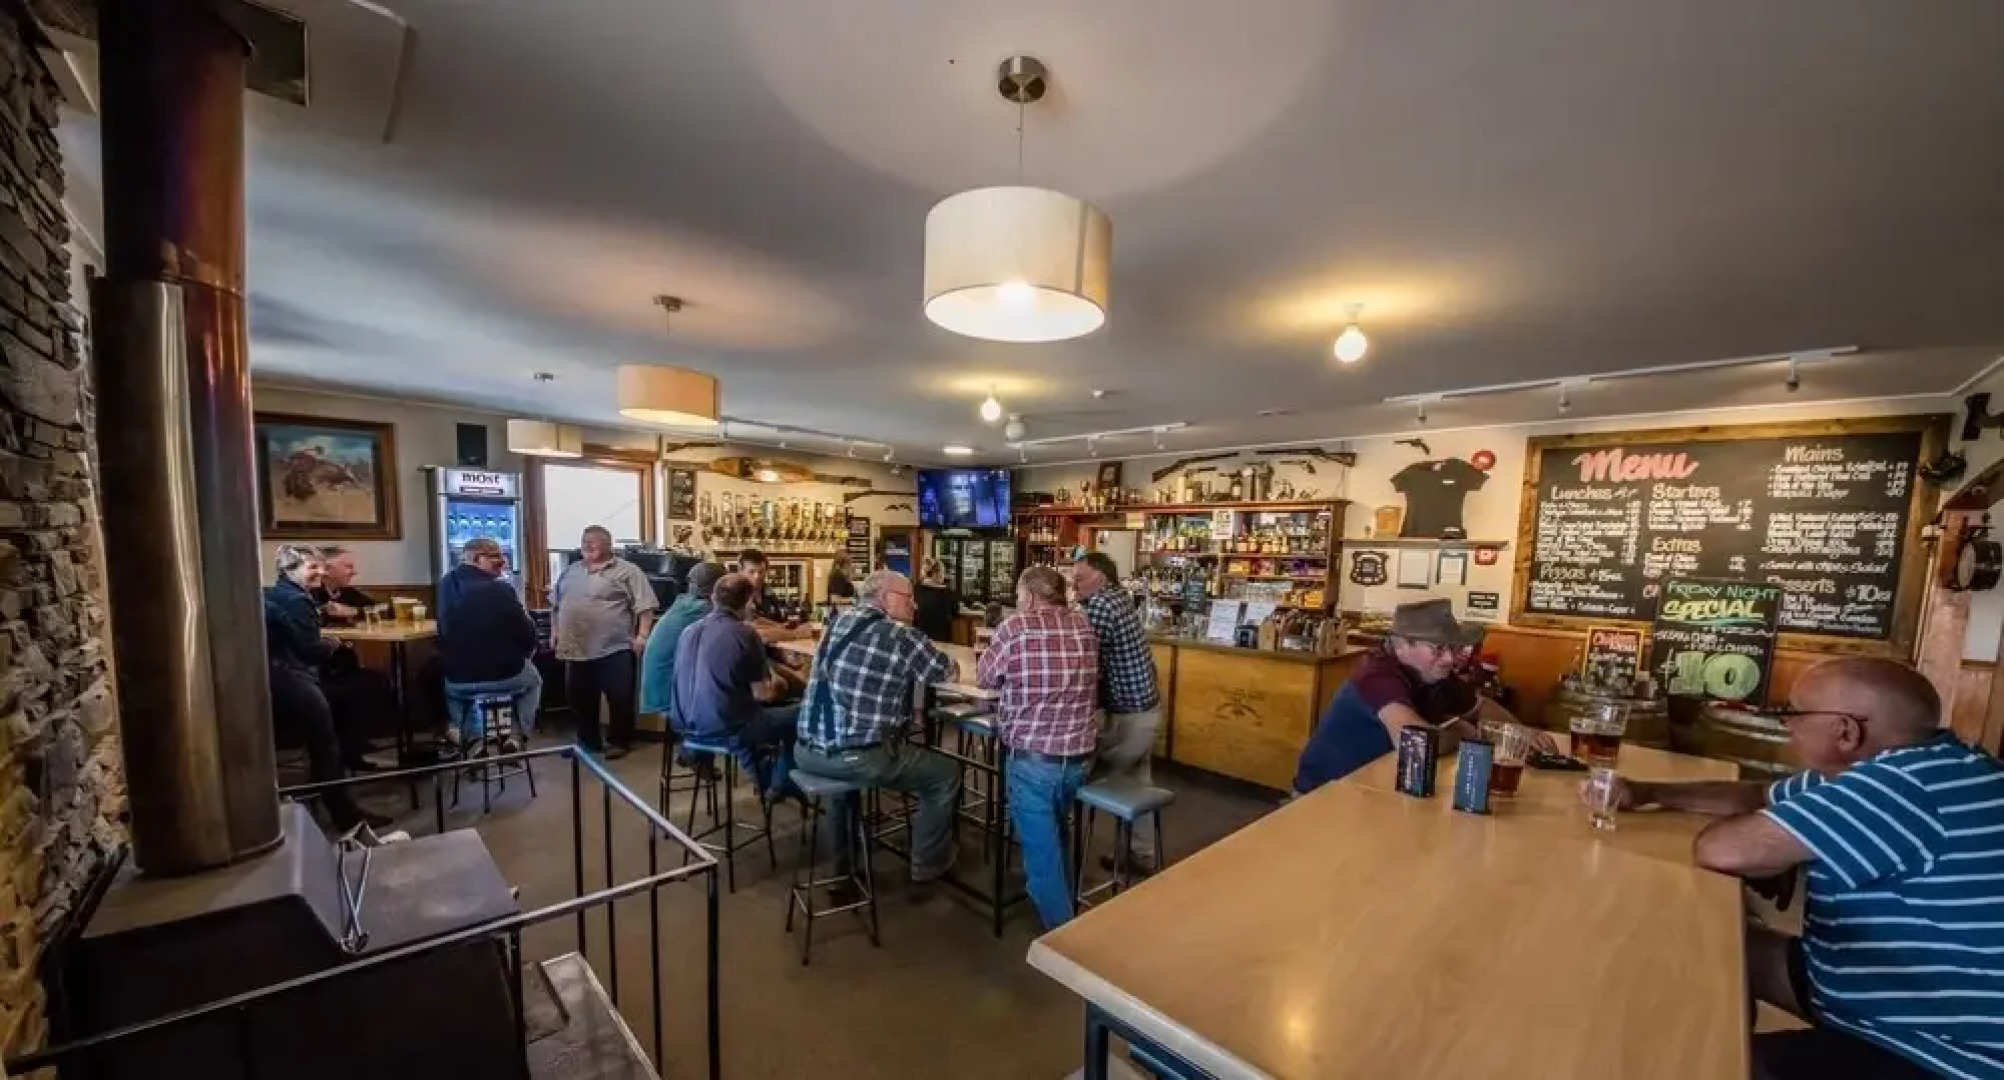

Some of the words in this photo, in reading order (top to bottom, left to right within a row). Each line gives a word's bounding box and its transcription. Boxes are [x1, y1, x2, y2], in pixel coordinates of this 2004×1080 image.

[1785, 443, 1844, 462] Mains
[1571, 449, 1700, 482] Menu
[1552, 485, 1612, 500] Lunches
[1726, 584, 1780, 600] NIGHT
[1663, 599, 1757, 617] SPECIAL
